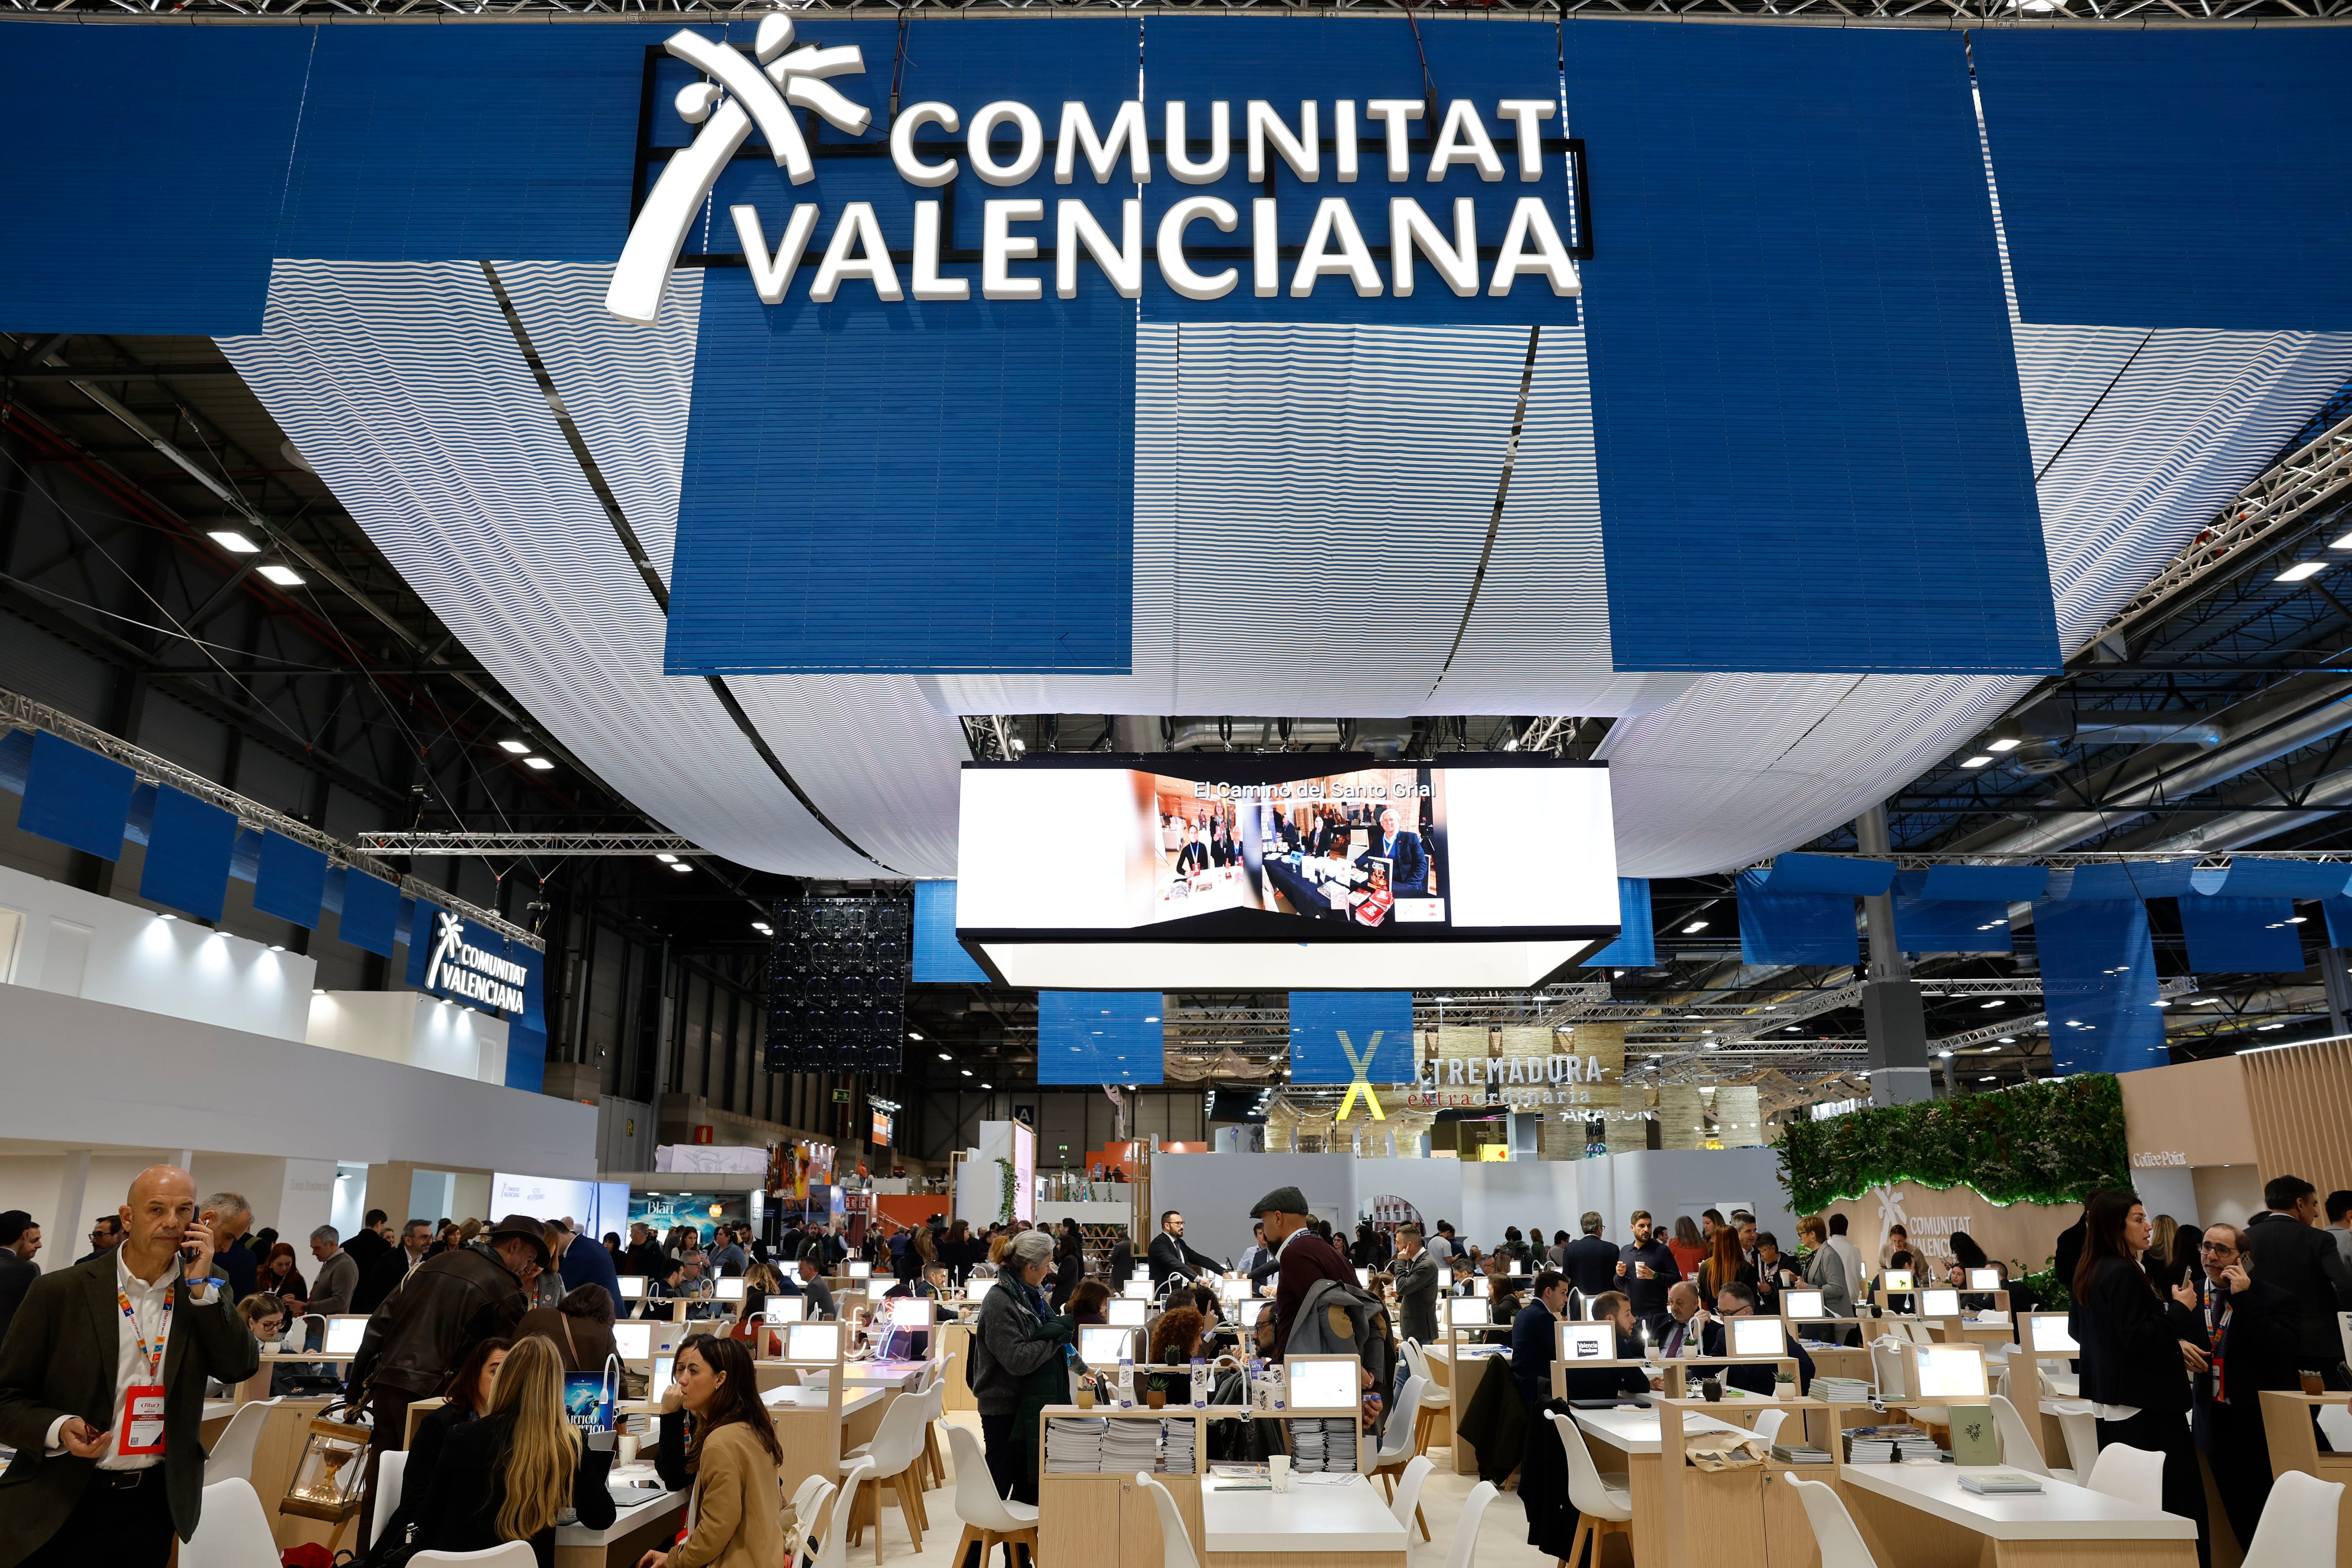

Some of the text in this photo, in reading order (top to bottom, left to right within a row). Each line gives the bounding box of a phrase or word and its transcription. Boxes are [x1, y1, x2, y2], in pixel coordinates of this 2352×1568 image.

[890, 100, 1557, 187] COMUNITAT
[730, 196, 1581, 305] VALENCIANA
[1193, 781, 1436, 798] El Camino del Santo Grial
[460, 944, 527, 987] COMUNITAT
[440, 963, 523, 1014] VALENCIANA
[1392, 1056, 1602, 1085] XTREMADURA
[1407, 1087, 1591, 1106] extraordinaria
[1018, 1108, 1031, 1122] A
[2133, 1151, 2187, 1167] Coffee Point
[1910, 1216, 1971, 1235] COMUNITAT
[660, 1363, 667, 1372] 2
[1296, 1366, 1302, 1376] 3
